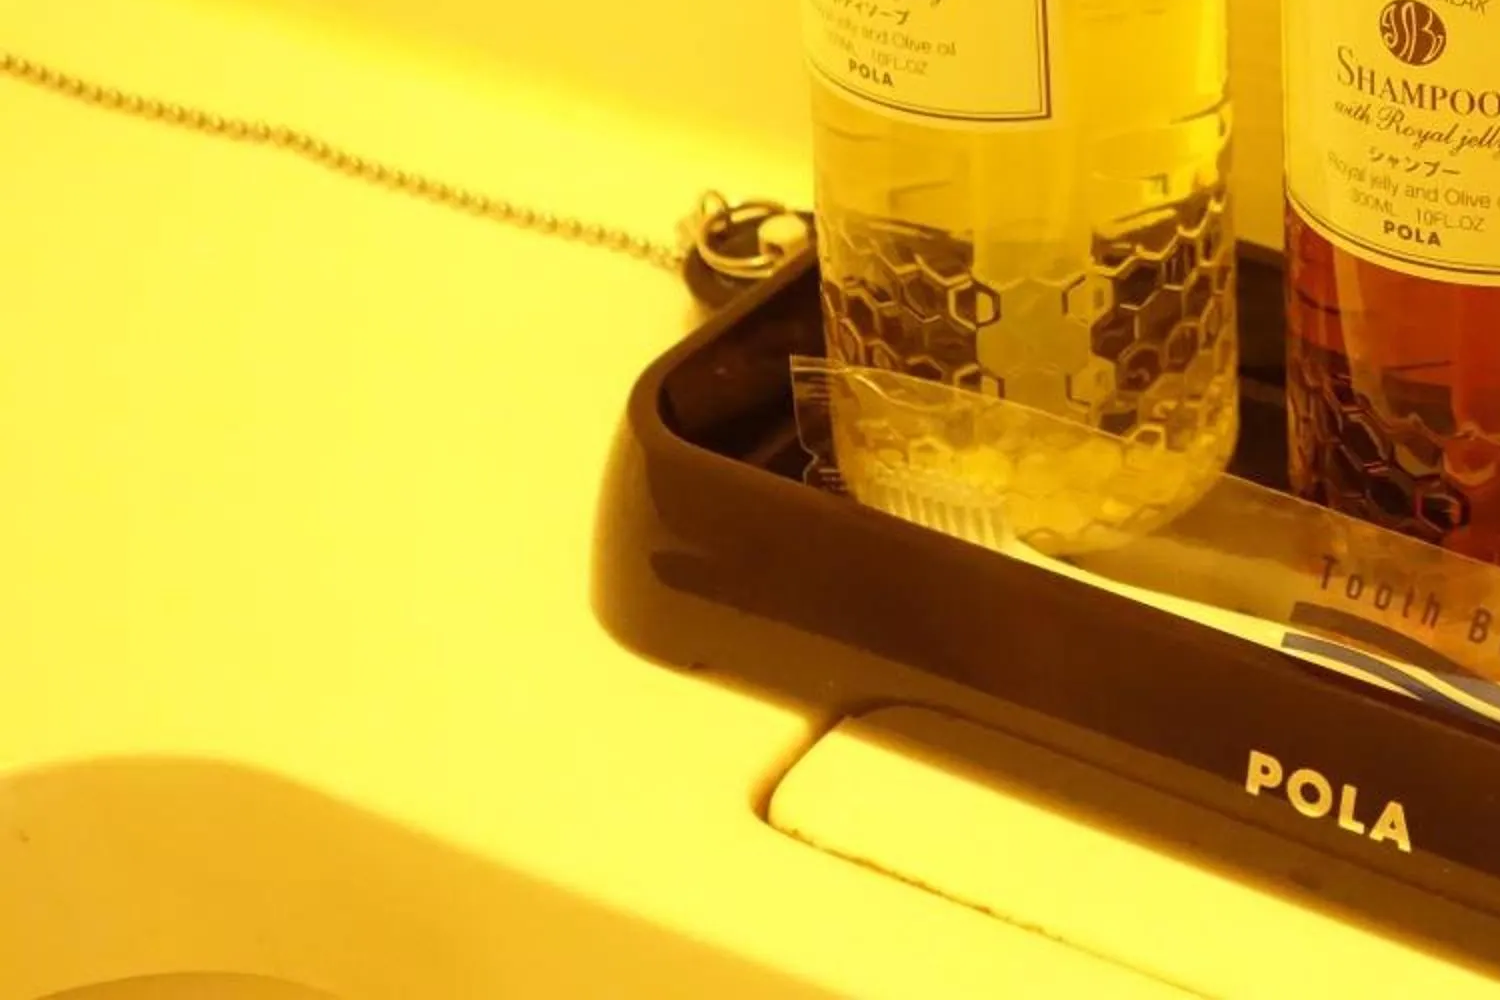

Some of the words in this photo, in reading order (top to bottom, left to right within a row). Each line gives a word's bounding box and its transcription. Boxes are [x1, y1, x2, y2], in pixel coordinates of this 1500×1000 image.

[892, 31, 932, 54] Olive
[937, 41, 957, 57] oil
[848, 56, 895, 87] POLA
[1334, 100, 1371, 125] with
[1375, 105, 1460, 150] Royal
[1368, 145, 1461, 178] シャンプー
[1370, 174, 1399, 197] jelly
[1404, 182, 1439, 203] and
[1444, 187, 1491, 209] Olive
[1383, 219, 1442, 247] POLA
[1319, 553, 1441, 628] Tooth
[1245, 749, 1412, 853] POLA
